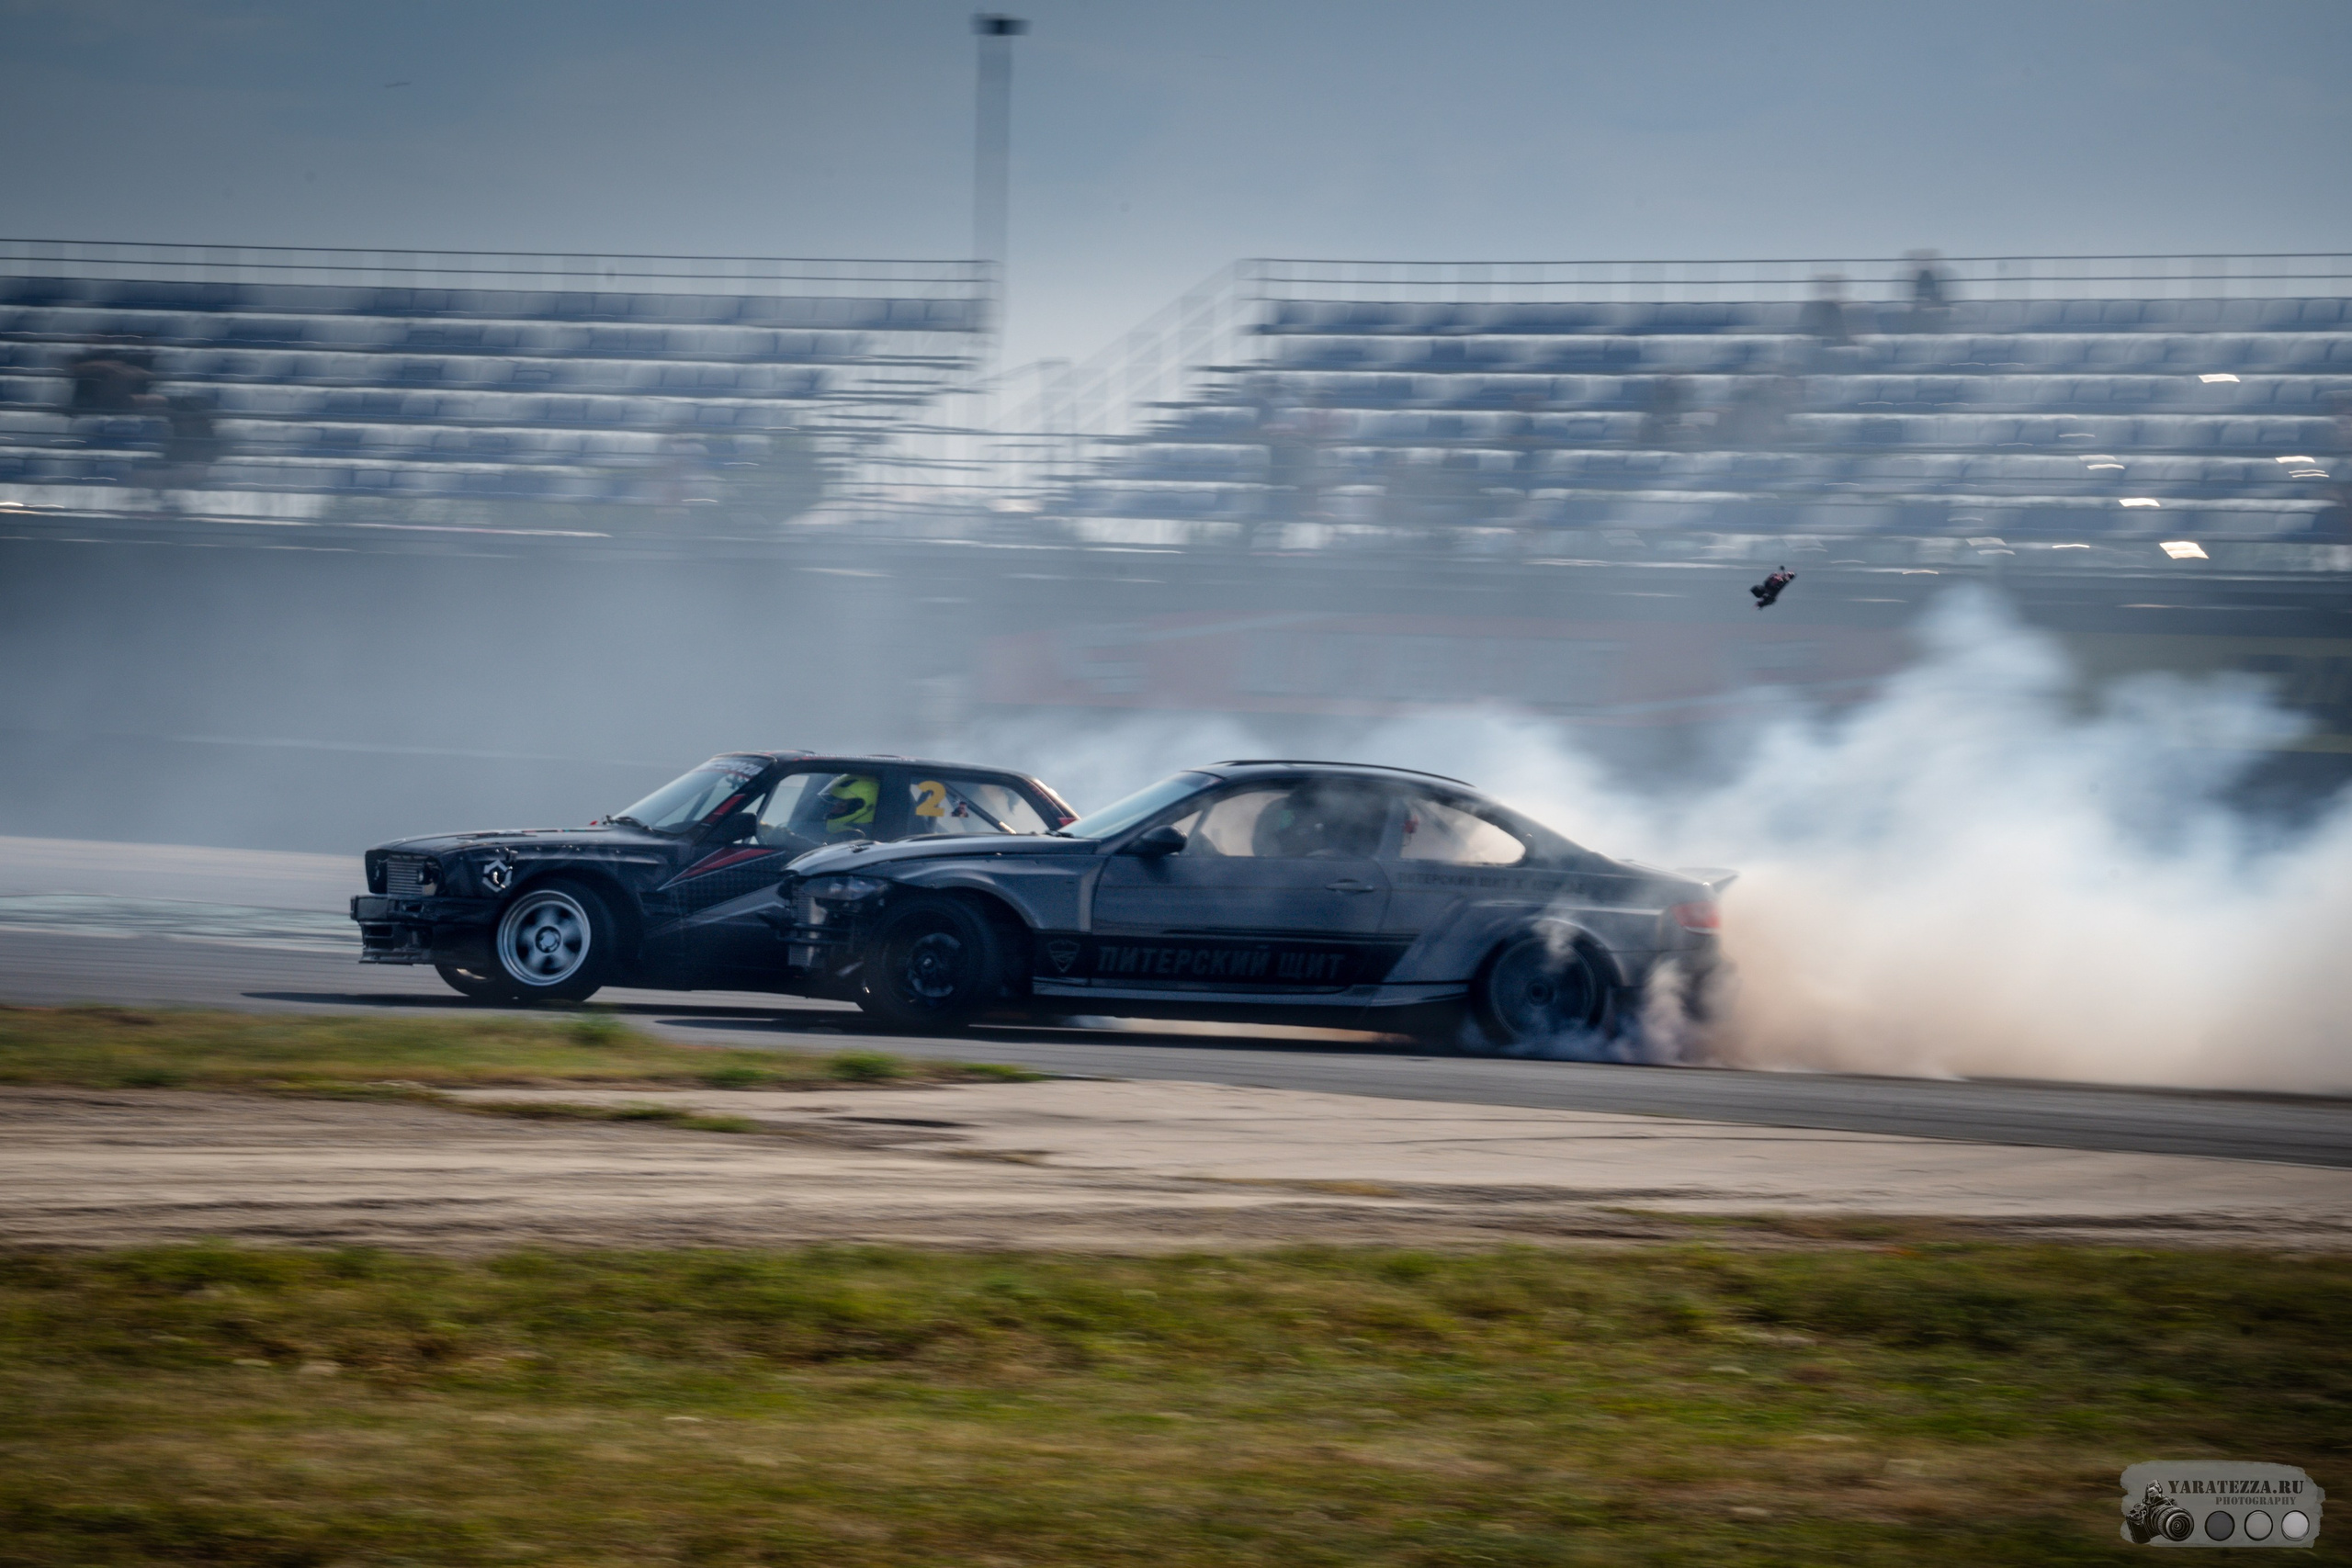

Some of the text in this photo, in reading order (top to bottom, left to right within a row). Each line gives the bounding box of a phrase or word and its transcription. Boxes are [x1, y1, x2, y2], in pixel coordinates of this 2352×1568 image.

[915, 780, 946, 818] 2
[1097, 944, 1346, 979] ПИТЕРСКИЙ ЩИТ
